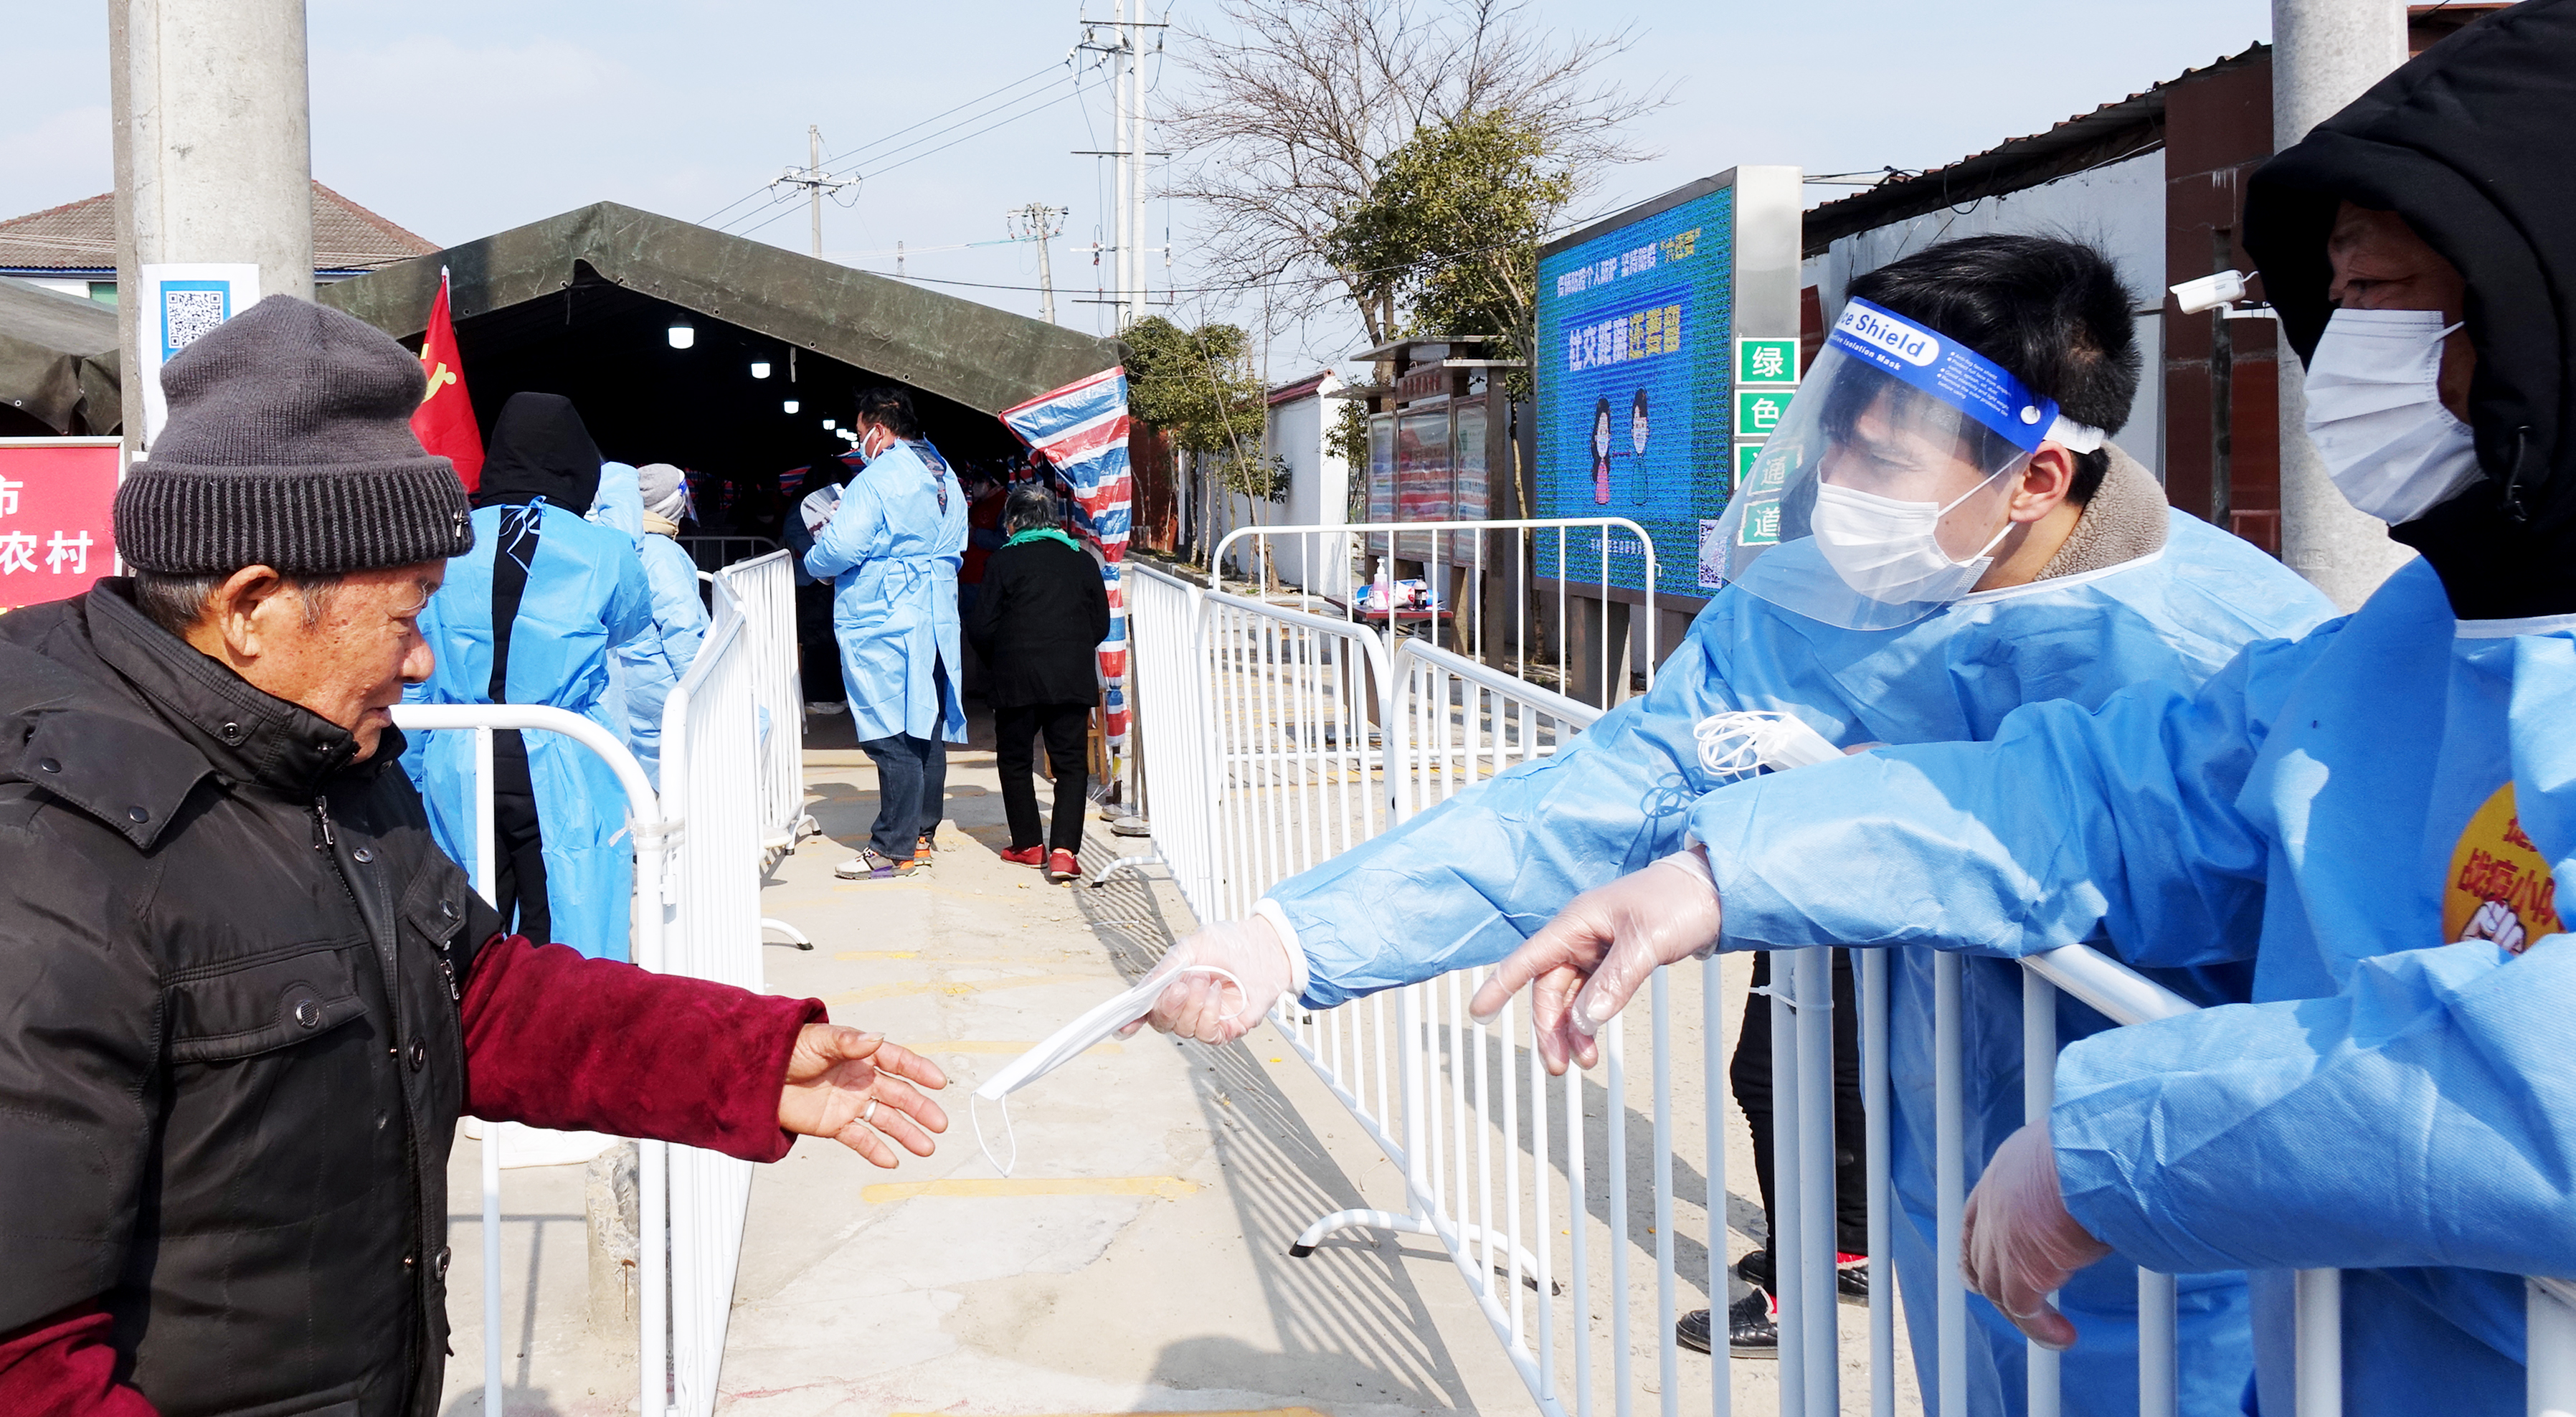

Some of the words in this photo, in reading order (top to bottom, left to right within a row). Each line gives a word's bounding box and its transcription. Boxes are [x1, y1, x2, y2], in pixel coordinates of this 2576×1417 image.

[1843, 338, 1875, 358] Isolation
[1876, 354, 1902, 371] Mask
[1856, 314, 1926, 357] Shield
[1951, 359, 1969, 371] Protect
[0, 530, 93, 575] 农村
